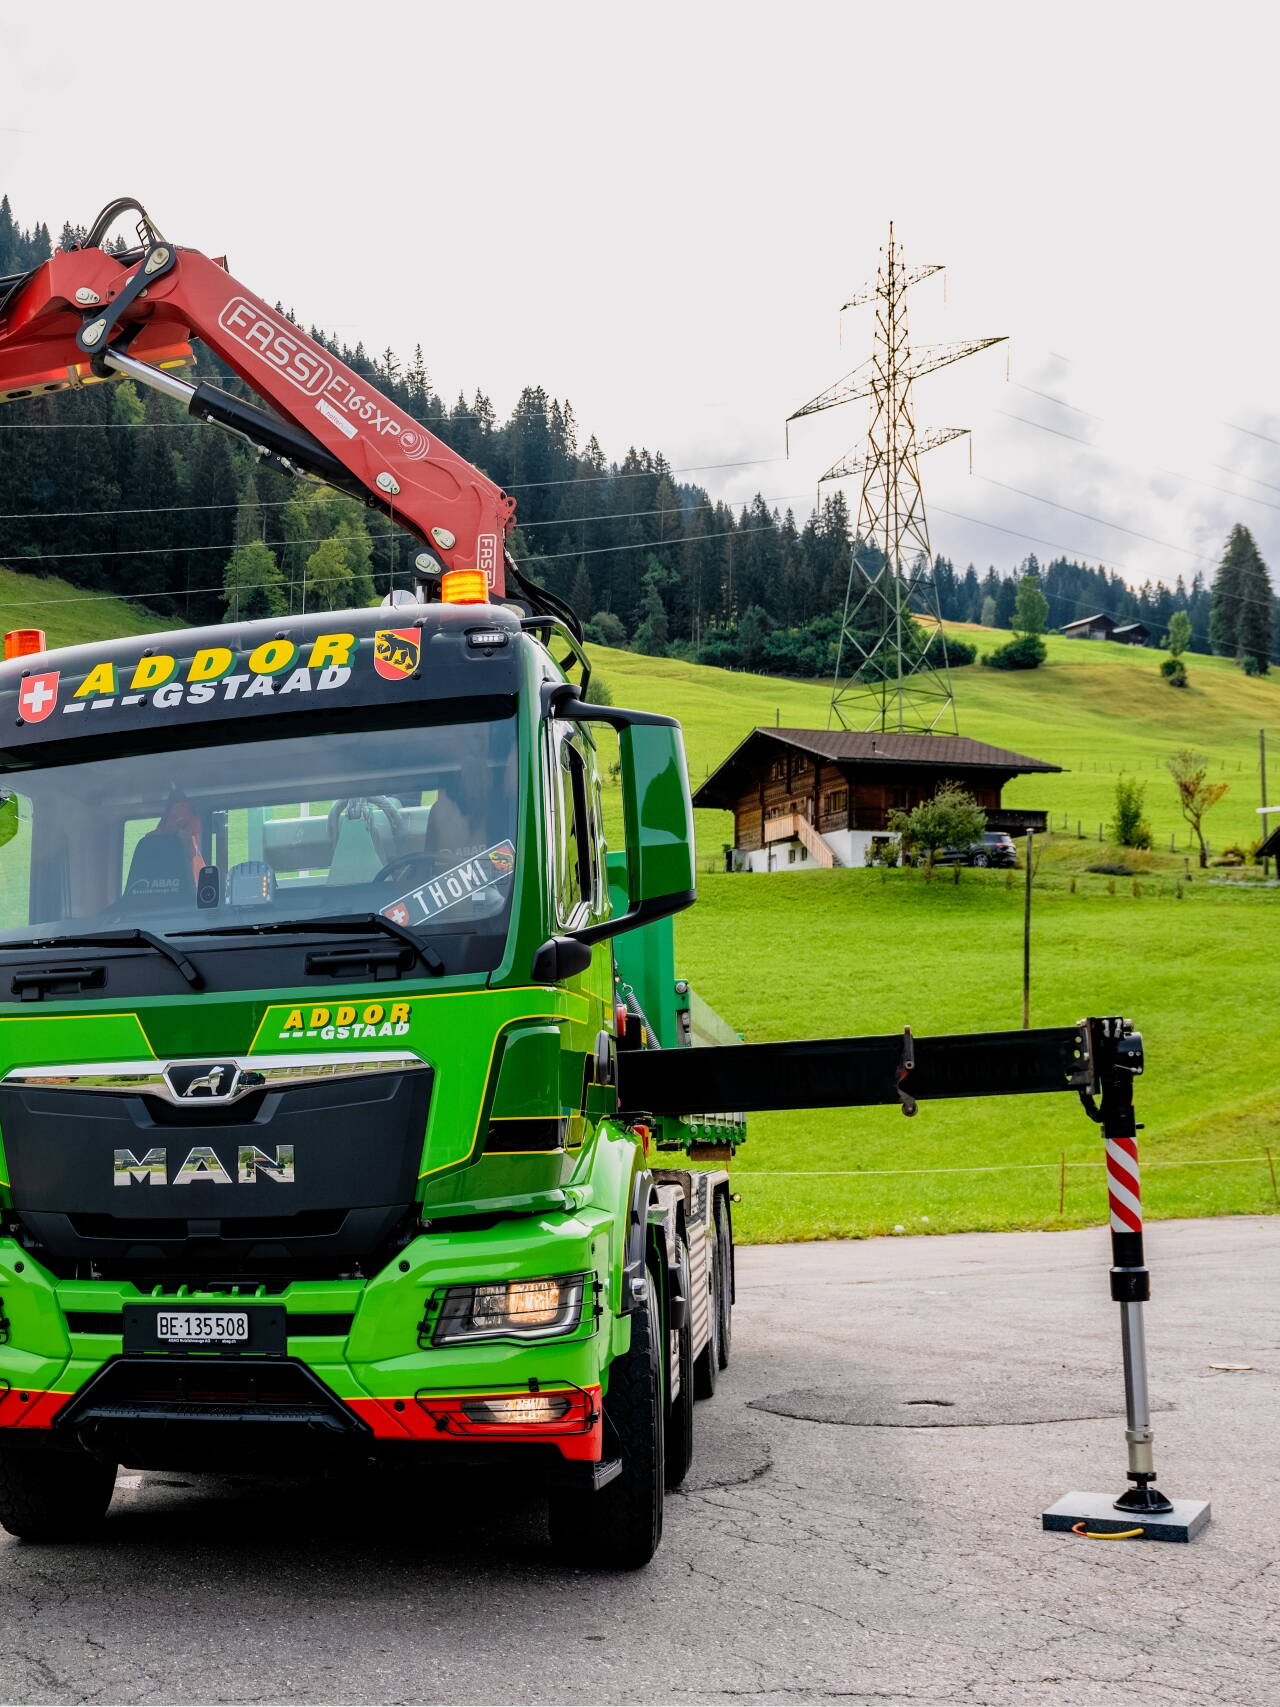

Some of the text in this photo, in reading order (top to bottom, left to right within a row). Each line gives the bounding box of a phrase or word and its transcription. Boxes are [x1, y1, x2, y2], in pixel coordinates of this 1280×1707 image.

[226, 304, 325, 389] FASSI
[327, 375, 402, 438] F165XP
[73, 633, 360, 701] ADDOR
[152, 666, 352, 709] GSTAAD
[412, 859, 489, 916] THÖMI
[283, 1003, 412, 1032] ADDOR
[320, 1021, 410, 1041] GSTAAD
[113, 1144, 295, 1187] MAN
